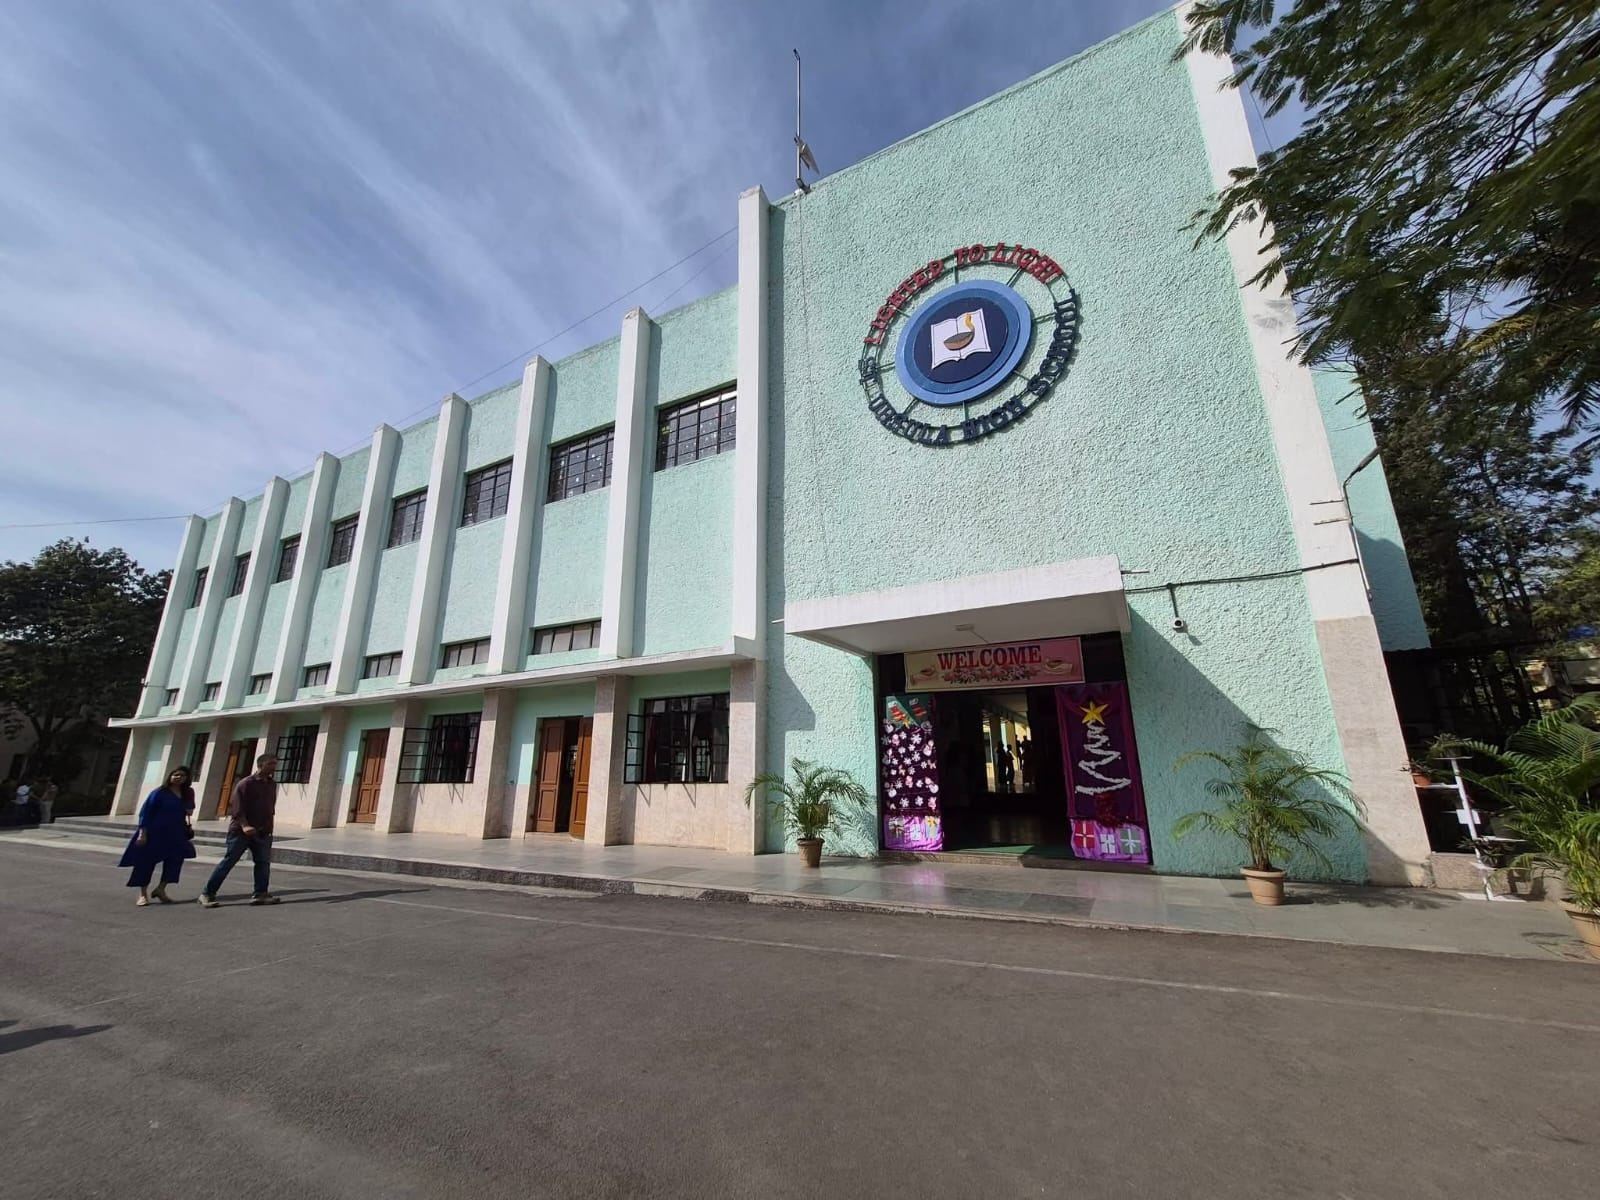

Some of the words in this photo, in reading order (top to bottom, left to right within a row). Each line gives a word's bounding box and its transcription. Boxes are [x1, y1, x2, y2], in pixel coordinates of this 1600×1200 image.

[954, 244, 984, 268] TO
[869, 394, 949, 445] URSULA
[961, 398, 1026, 440] HIGH
[1027, 289, 1077, 396] SCHOOL
[937, 645, 1041, 670] WELCOME
